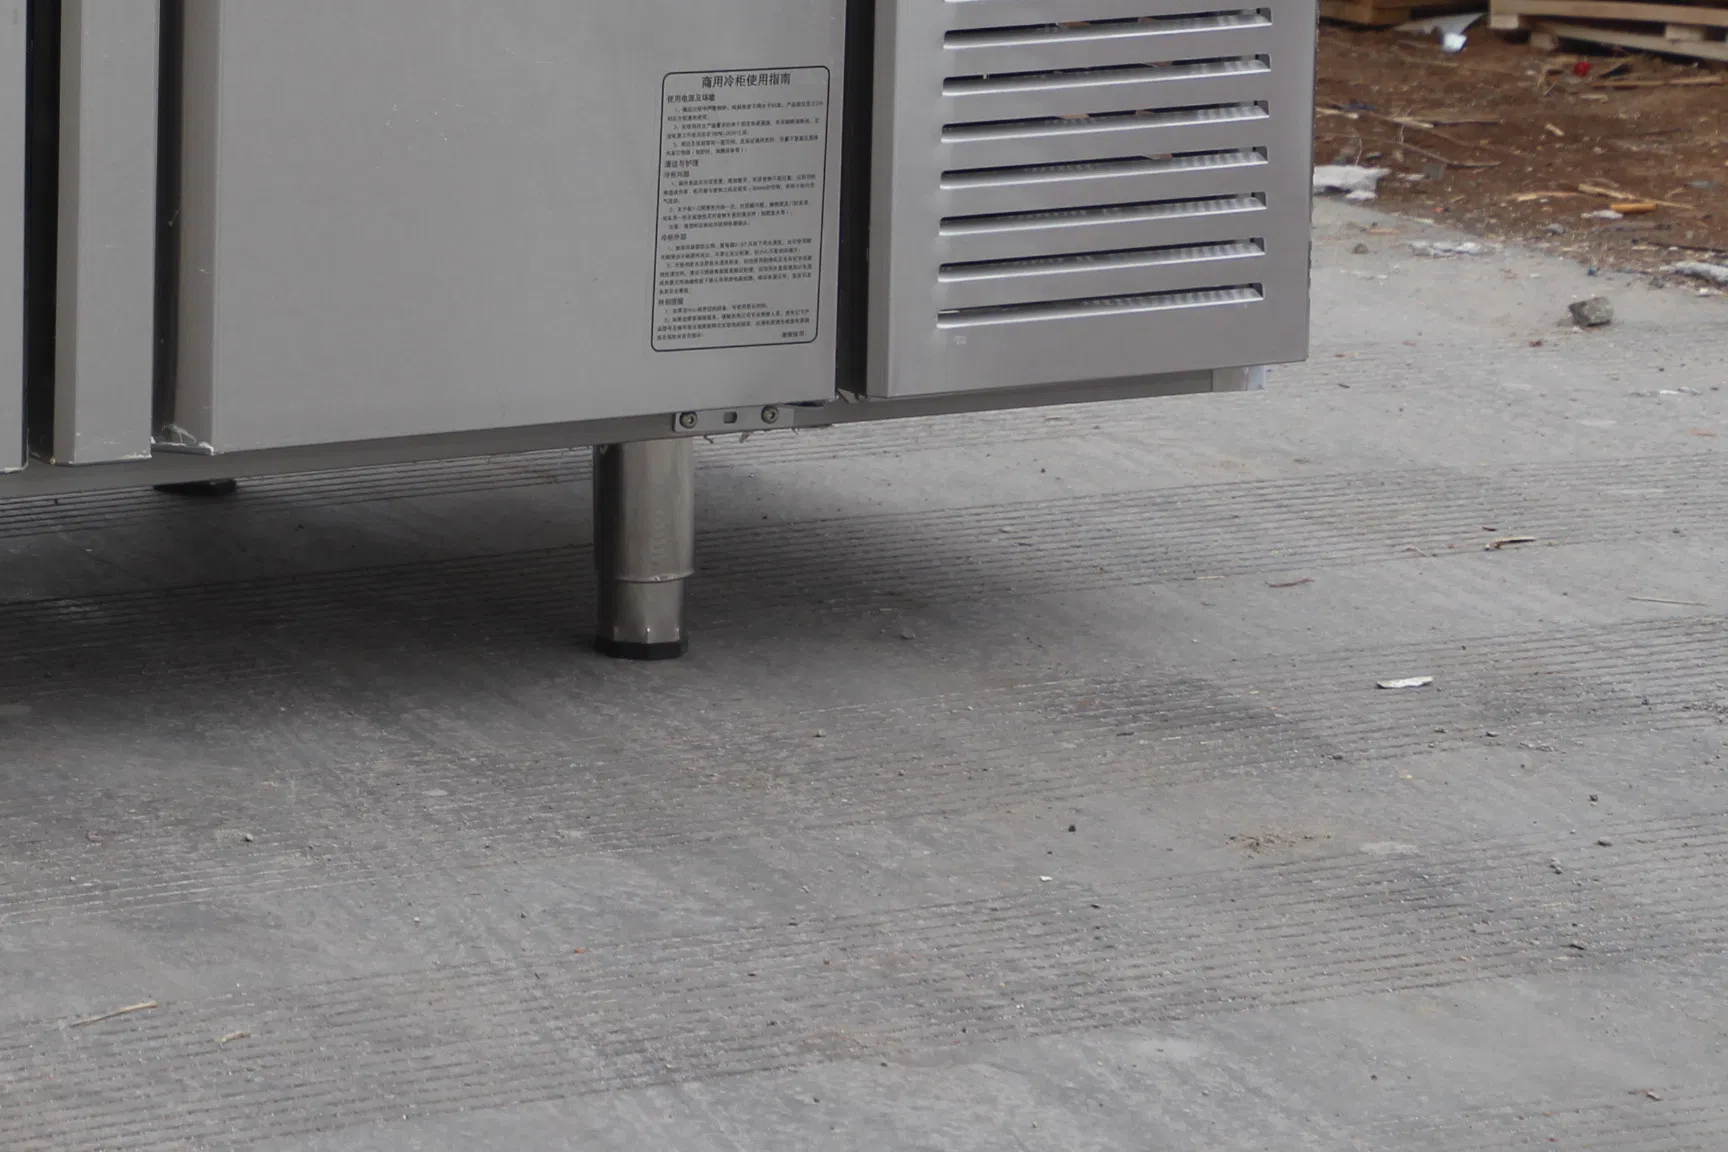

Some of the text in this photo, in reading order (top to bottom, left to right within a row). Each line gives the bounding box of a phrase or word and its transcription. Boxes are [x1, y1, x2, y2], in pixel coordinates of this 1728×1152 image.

[701, 72, 791, 89] 商用冷柜使用指南
